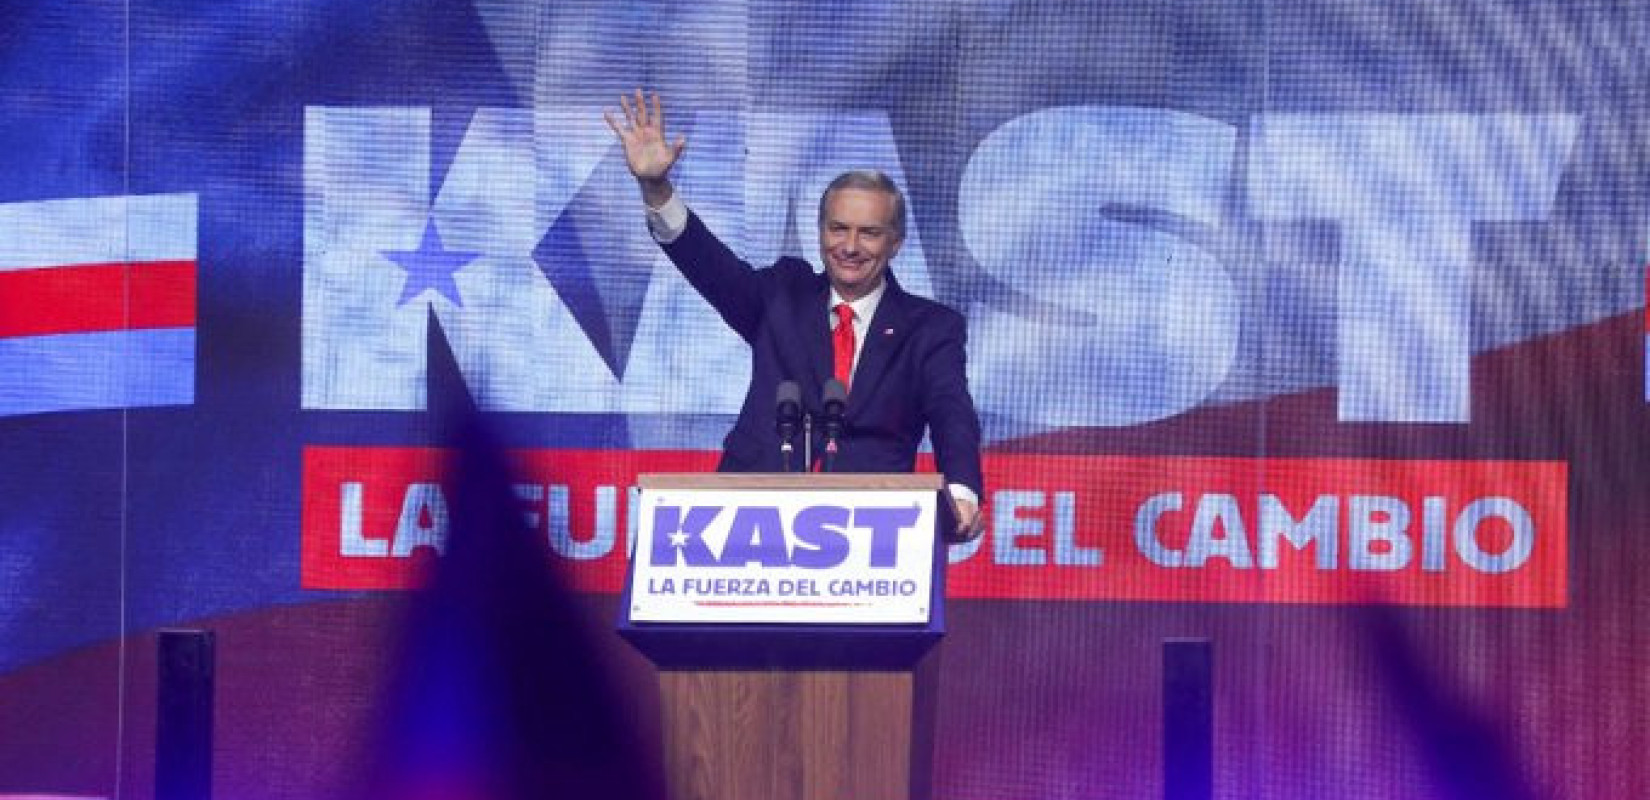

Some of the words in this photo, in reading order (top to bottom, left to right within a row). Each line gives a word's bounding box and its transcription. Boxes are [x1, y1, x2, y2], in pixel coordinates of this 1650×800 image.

[340, 483, 450, 558] LA
[948, 490, 1105, 566] EL
[1133, 493, 1535, 574] CAMBIO
[649, 504, 922, 569] KAST
[648, 578, 676, 595] LA
[682, 578, 771, 596] FUERZA
[778, 579, 821, 597] DEL
[827, 578, 917, 597] CAMBIO
